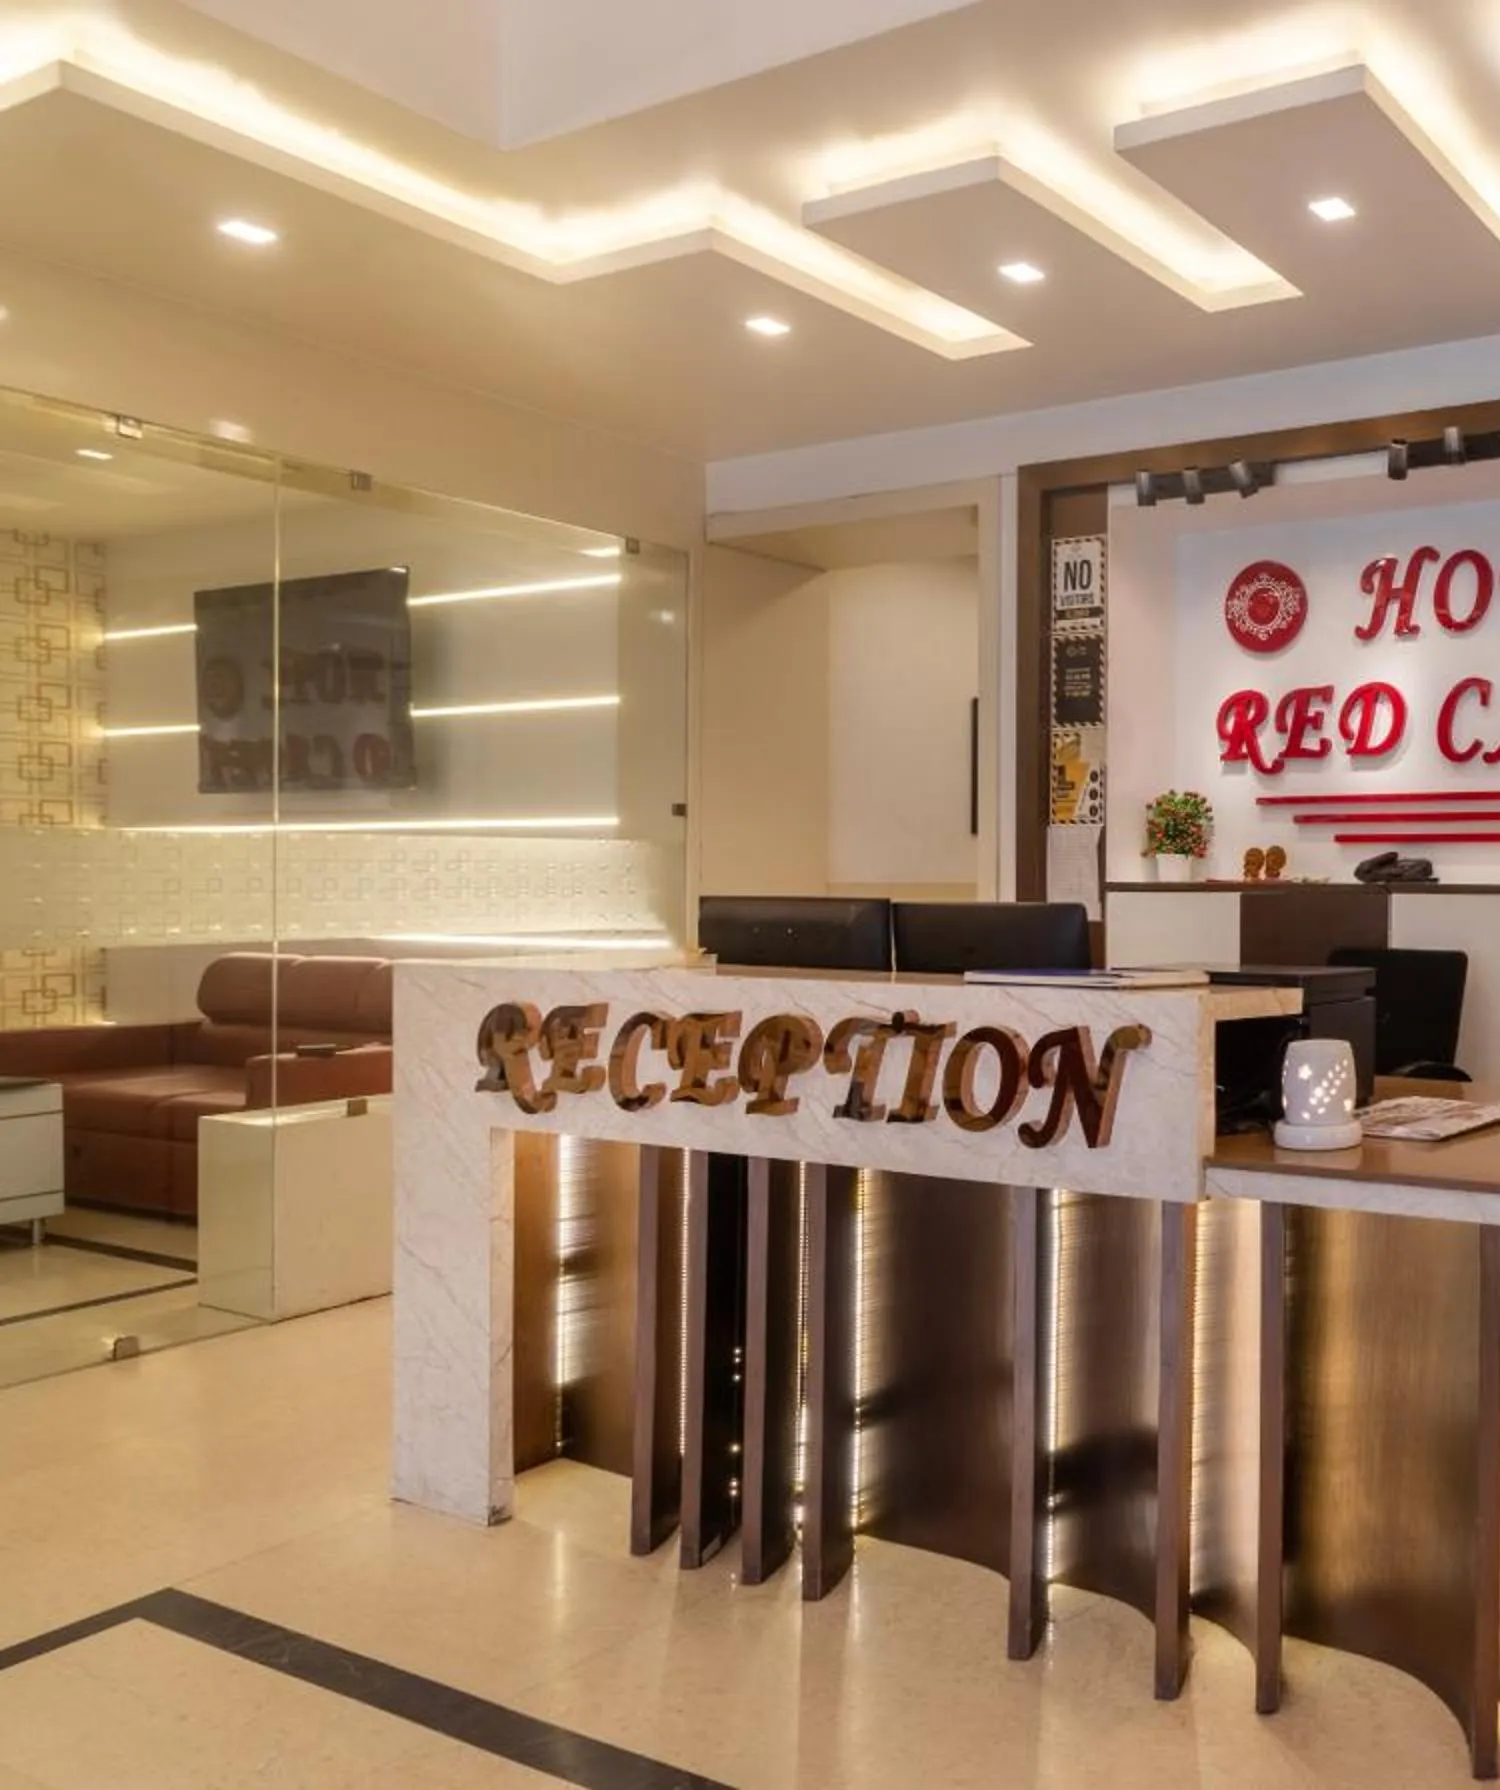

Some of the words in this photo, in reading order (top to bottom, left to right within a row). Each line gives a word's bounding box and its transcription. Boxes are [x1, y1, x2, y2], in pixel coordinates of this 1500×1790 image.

[1063, 559, 1093, 592] NO
[1217, 681, 1408, 774] RED
[474, 1000, 1153, 1150] RECEPTION
